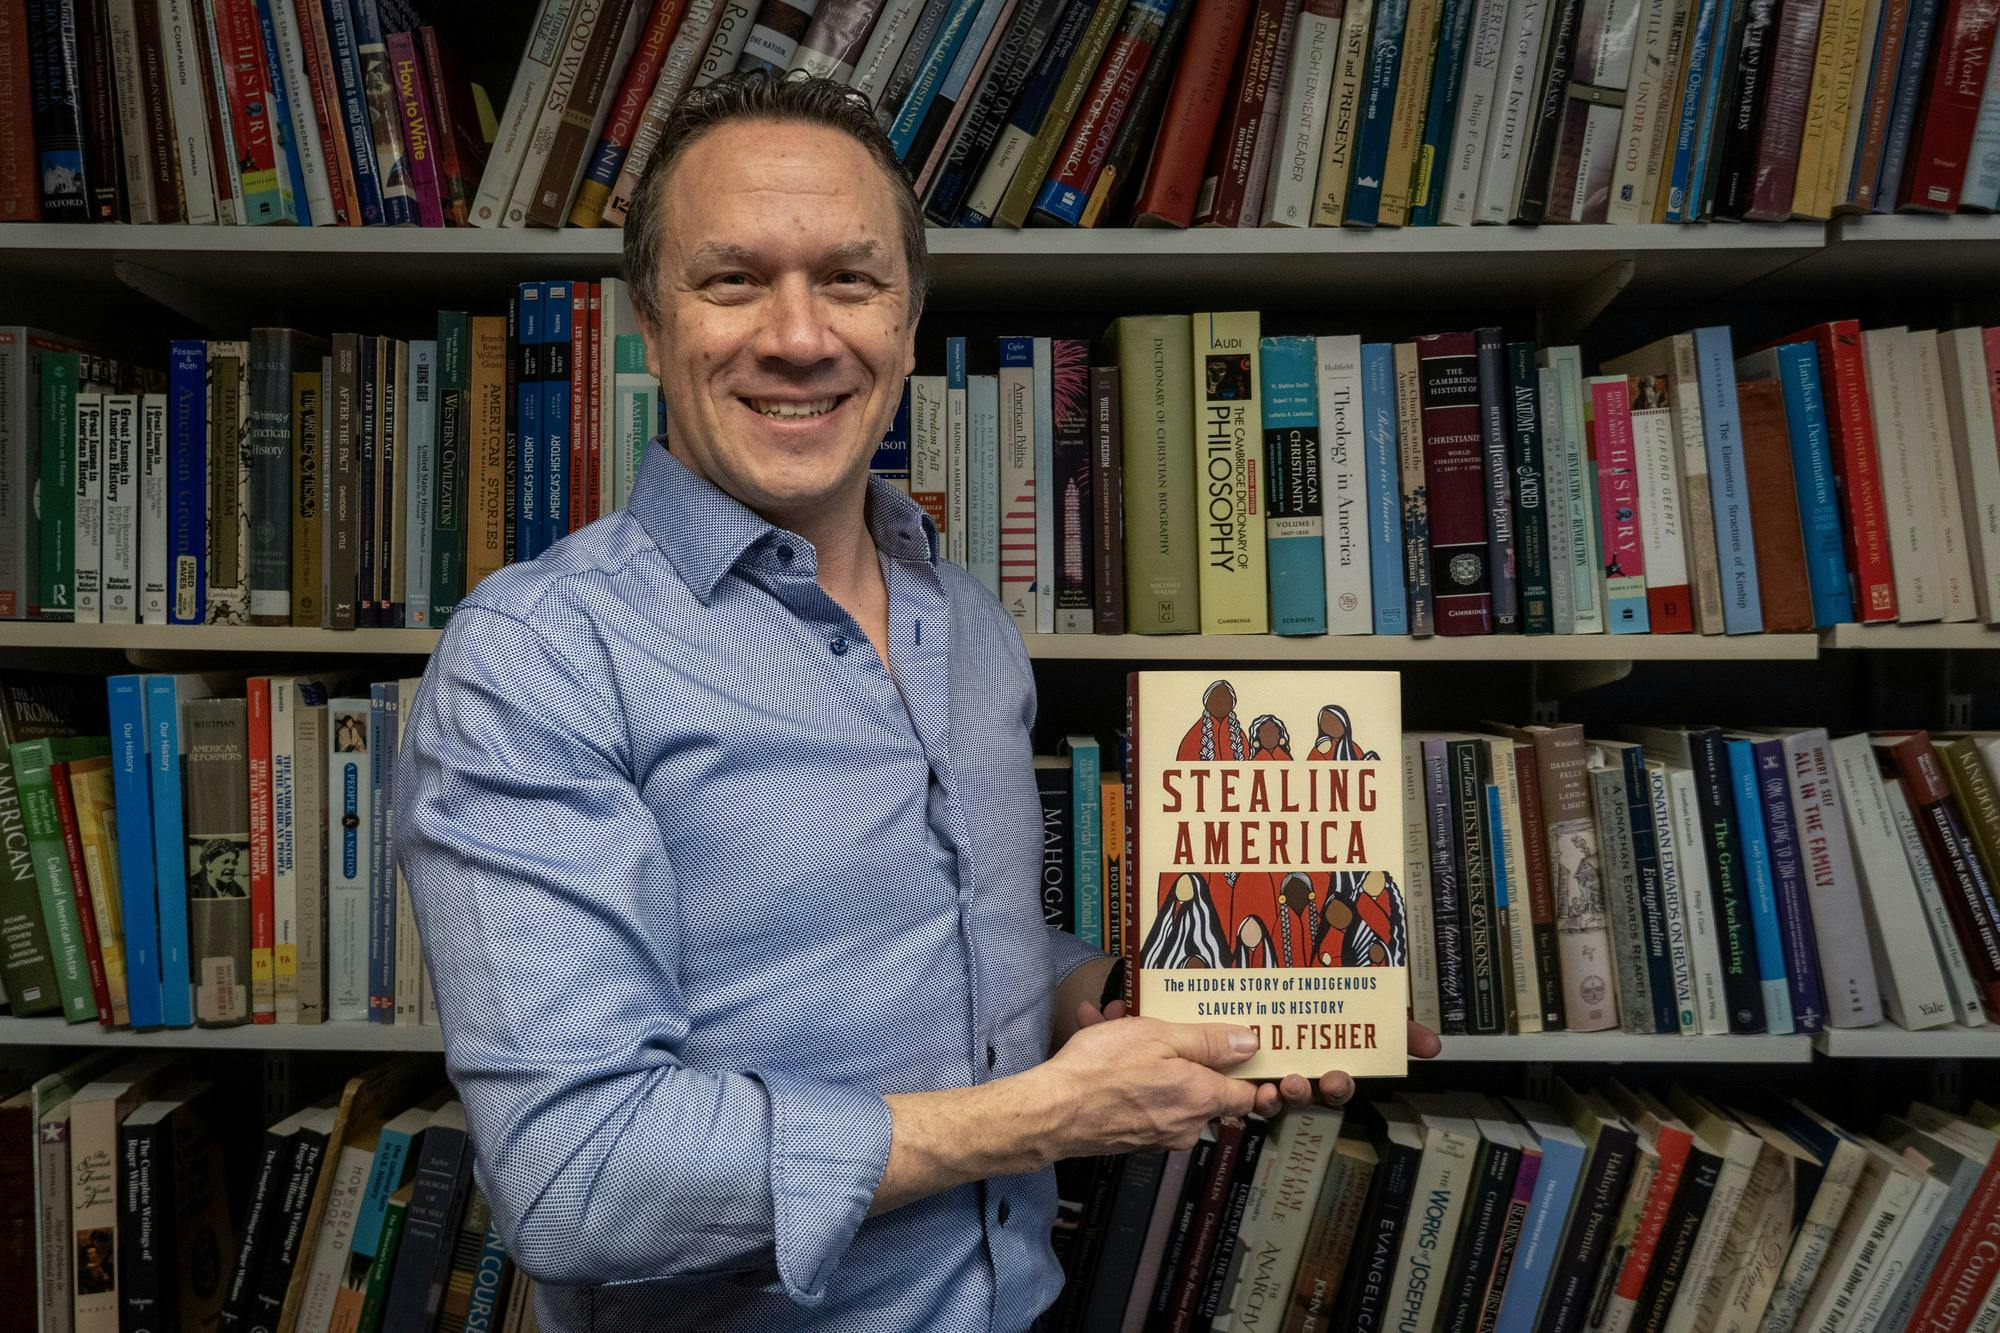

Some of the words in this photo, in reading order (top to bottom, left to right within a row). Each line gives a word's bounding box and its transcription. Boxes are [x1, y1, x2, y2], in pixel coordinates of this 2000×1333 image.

[570, 0, 600, 52] GOOD
[642, 0, 676, 62] SPIRIT
[700, 4, 748, 80] Rachel
[750, 36, 762, 45] ONE
[1256, 10, 1270, 39] NEW
[1269, 20, 1278, 29] A
[1347, 24, 1364, 58] PAST
[174, 25, 187, 85] COMPANION
[634, 62, 650, 83] OF
[1076, 47, 1098, 83] American
[1100, 40, 1131, 96] HISTORY
[1243, 41, 1264, 104] FORTUNES
[1258, 32, 1277, 82] HAZARD
[1344, 60, 1356, 78] and
[1689, 41, 1707, 72] What
[398, 60, 415, 96] How
[548, 56, 580, 113] WIVES
[647, 44, 694, 122] SEBASTIAN
[1119, 68, 1139, 97] THE
[1255, 83, 1265, 101] OF
[1299, 22, 1327, 128] ENLIGHTENMENT
[405, 101, 419, 118] to
[1063, 83, 1084, 113] Women
[1088, 99, 1106, 118] OF
[1467, 94, 1484, 127] Philip
[1631, 81, 1650, 132] UNDER
[1683, 74, 1702, 116] Objects
[409, 117, 426, 160] Write
[601, 87, 642, 166] VATICAN
[1087, 98, 1125, 166] RELIGIOUS
[1242, 118, 1257, 158] WILLIAM
[1332, 82, 1354, 168] PRESENT
[1467, 129, 1477, 139] F.
[1679, 119, 1694, 150] Mean
[188, 137, 198, 176] CHAPMAN
[625, 122, 663, 177] JUNGER
[997, 137, 1019, 168] Whicher
[1062, 121, 1093, 177] AMERICA
[1231, 127, 1246, 171] HOWELLS
[1291, 133, 1309, 182] READER
[1461, 143, 1475, 171] Gura
[1624, 137, 1641, 172] GOD
[596, 168, 611, 179] II
[1236, 159, 1249, 186] DEAN
[44, 199, 83, 207] OXFORD
[1214, 339, 1242, 348] AUDI
[1153, 338, 1164, 408] DICTIONARY
[1797, 357, 1816, 413] Handbook
[120, 408, 131, 438] Great
[225, 388, 235, 423] THAT
[339, 387, 348, 421] AFTER
[443, 393, 458, 447] WESTERN
[1015, 383, 1025, 432] American
[1100, 397, 1109, 422] VOICES
[1156, 410, 1165, 425] OF
[1233, 406, 1244, 425] THE
[108, 409, 119, 461] American
[340, 423, 348, 445] THE
[489, 383, 500, 467] AMERICAN
[1100, 424, 1109, 432] OF
[1330, 386, 1351, 467] Theology
[1490, 406, 1501, 443] BETWEEN
[1719, 422, 1730, 440] The
[120, 439, 131, 473] Issues
[225, 425, 235, 469] NOBLE
[339, 448, 348, 473] FACT
[1015, 435, 1026, 469] Politics
[1100, 435, 1110, 468] FREEDOM
[1156, 429, 1166, 488] CHRISTIAN
[1235, 427, 1245, 488] CAMBRIDGE
[1489, 444, 1504, 489] Heaven
[1655, 418, 1670, 480] CLIFFORD
[1808, 423, 1828, 505] Denominations
[107, 463, 119, 502] History
[120, 474, 131, 485] in
[441, 449, 456, 525] CIVILIZATION
[1206, 406, 1235, 572] PHILOSOPHY
[1290, 429, 1304, 513] CHRISTIANITY
[1305, 439, 1317, 504] AMERICAN
[1337, 473, 1353, 493] in
[1721, 445, 1737, 499] Elementary
[225, 470, 235, 516] DREAM
[1495, 490, 1505, 507] AND
[1662, 488, 1675, 536] GEERTZ
[487, 477, 499, 550] STORIES
[1158, 491, 1170, 556] BIOGRAPHY
[1236, 490, 1247, 553] DICTIONARY
[1339, 498, 1356, 567] America
[1492, 508, 1508, 543] Earth
[1727, 505, 1742, 553] Structures
[1238, 554, 1248, 570] OF
[1733, 556, 1743, 568] of
[1735, 571, 1748, 609] Kinship
[159, 722, 169, 739] Our
[159, 741, 171, 772] History
[347, 764, 355, 772] A
[1794, 751, 1811, 778] ALL
[346, 773, 355, 812] PEOPLE
[1162, 769, 1377, 813] STEALING
[1650, 772, 1669, 848] JONATHAN
[1801, 784, 1817, 800] IN
[346, 817, 356, 826] &
[347, 829, 355, 837] A
[1463, 799, 1478, 832] FITS,
[1713, 818, 1729, 850] The
[1803, 804, 1821, 832] THE
[346, 839, 356, 879] NATION
[1173, 821, 1368, 865] AMERICA
[1809, 837, 1834, 888] FAMILY
[46, 856, 60, 896] Colonial
[1466, 831, 1484, 901] TRANCES,
[1661, 851, 1679, 920] EDWARDS
[1718, 852, 1734, 894] Great
[52, 898, 72, 944] American
[1471, 904, 1485, 917] &
[1472, 917, 1488, 977] VISIONS
[1668, 921, 1681, 944] ON
[1723, 897, 1744, 976] Awakening
[64, 945, 79, 981] History
[1672, 947, 1690, 1006] REVIVAL
[1164, 979, 1184, 992] The
[1188, 979, 1235, 992] HIDDEN
[1240, 978, 1278, 992] STORY
[1282, 977, 1294, 991] of
[1298, 977, 1377, 990] INDIGENOUS
[1198, 1002, 1252, 1015] SLAVERY
[1257, 1002, 1266, 1015] in
[1271, 1002, 1286, 1015] US
[1290, 1001, 1344, 1014] HISTORY
[1272, 1024, 1290, 1050] D.
[1297, 1024, 1377, 1050] FISHER
[127, 1139, 139, 1168] Roger
[140, 1138, 151, 1157] The
[139, 1158, 151, 1205] Complete
[1272, 1116, 1313, 1221] DALRYMPLE
[1440, 1170, 1451, 1186] THE
[1595, 1151, 1622, 1209] Hakluyt's
[129, 1170, 140, 1213] Williams
[140, 1206, 152, 1245] Writings
[1419, 1190, 1451, 1249] WORKS
[1578, 1212, 1603, 1263] Promise
[142, 1247, 152, 1261] of
[1421, 1249, 1430, 1261] of
